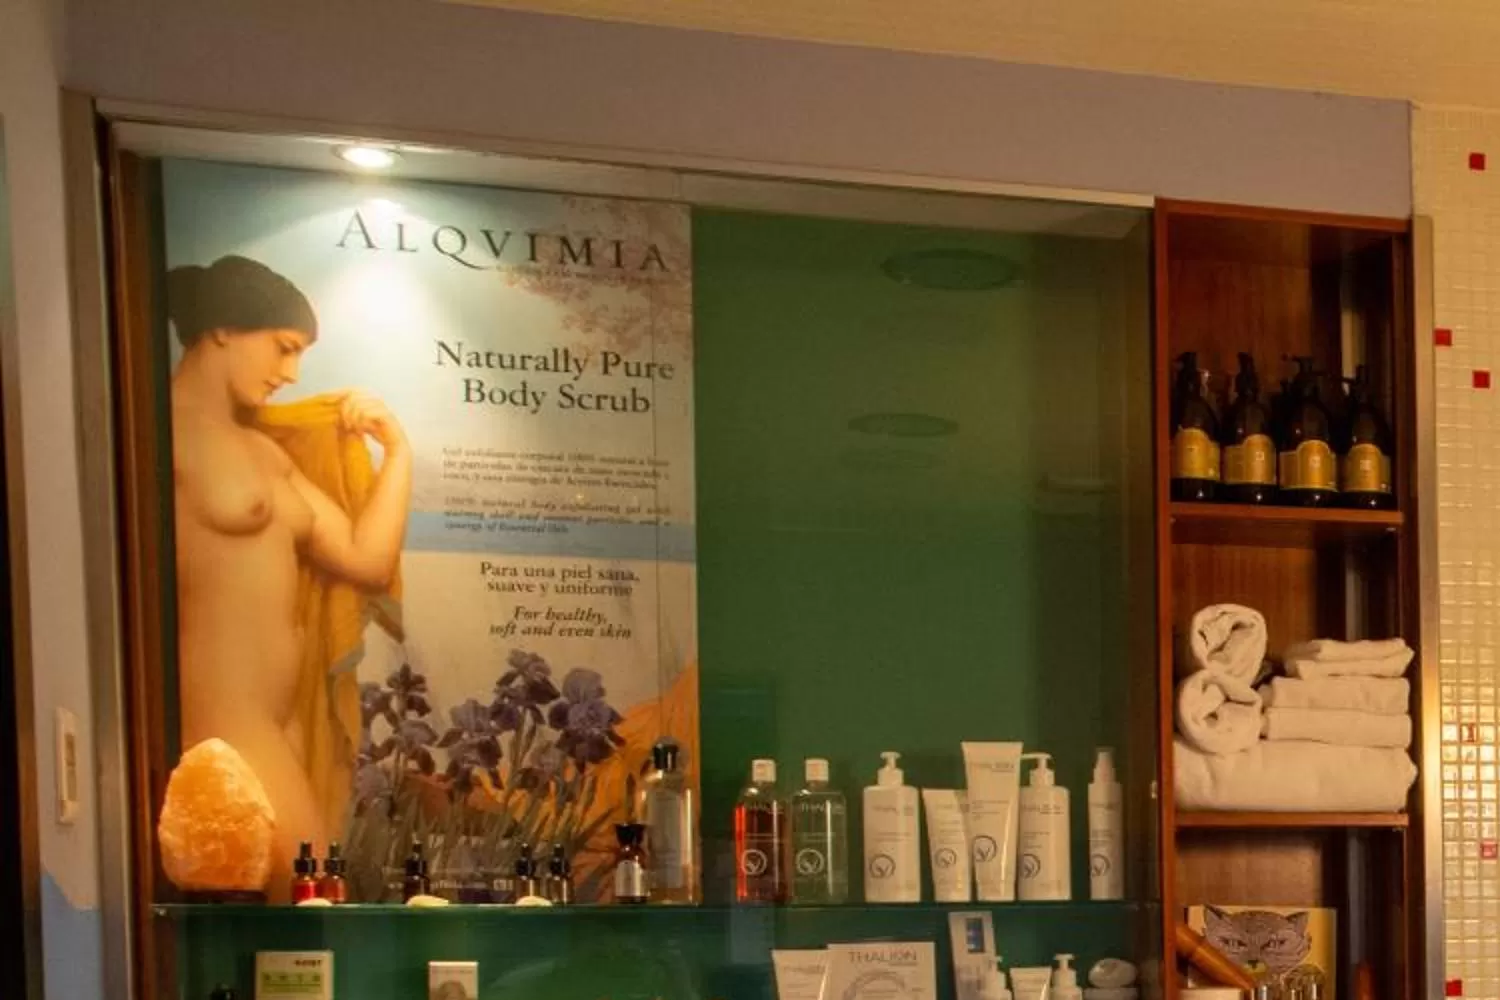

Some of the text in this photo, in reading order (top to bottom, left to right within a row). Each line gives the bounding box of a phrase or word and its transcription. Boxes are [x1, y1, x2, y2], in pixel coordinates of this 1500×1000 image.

[335, 207, 670, 272] ALQVIMIA
[434, 340, 675, 381] Naturally Pure
[463, 378, 651, 415] Body Scrub
[480, 561, 640, 583] Para una piel sana,
[487, 580, 633, 597] suave y uniforme
[513, 605, 608, 625] For healthy,
[490, 622, 632, 639] soft and even skin
